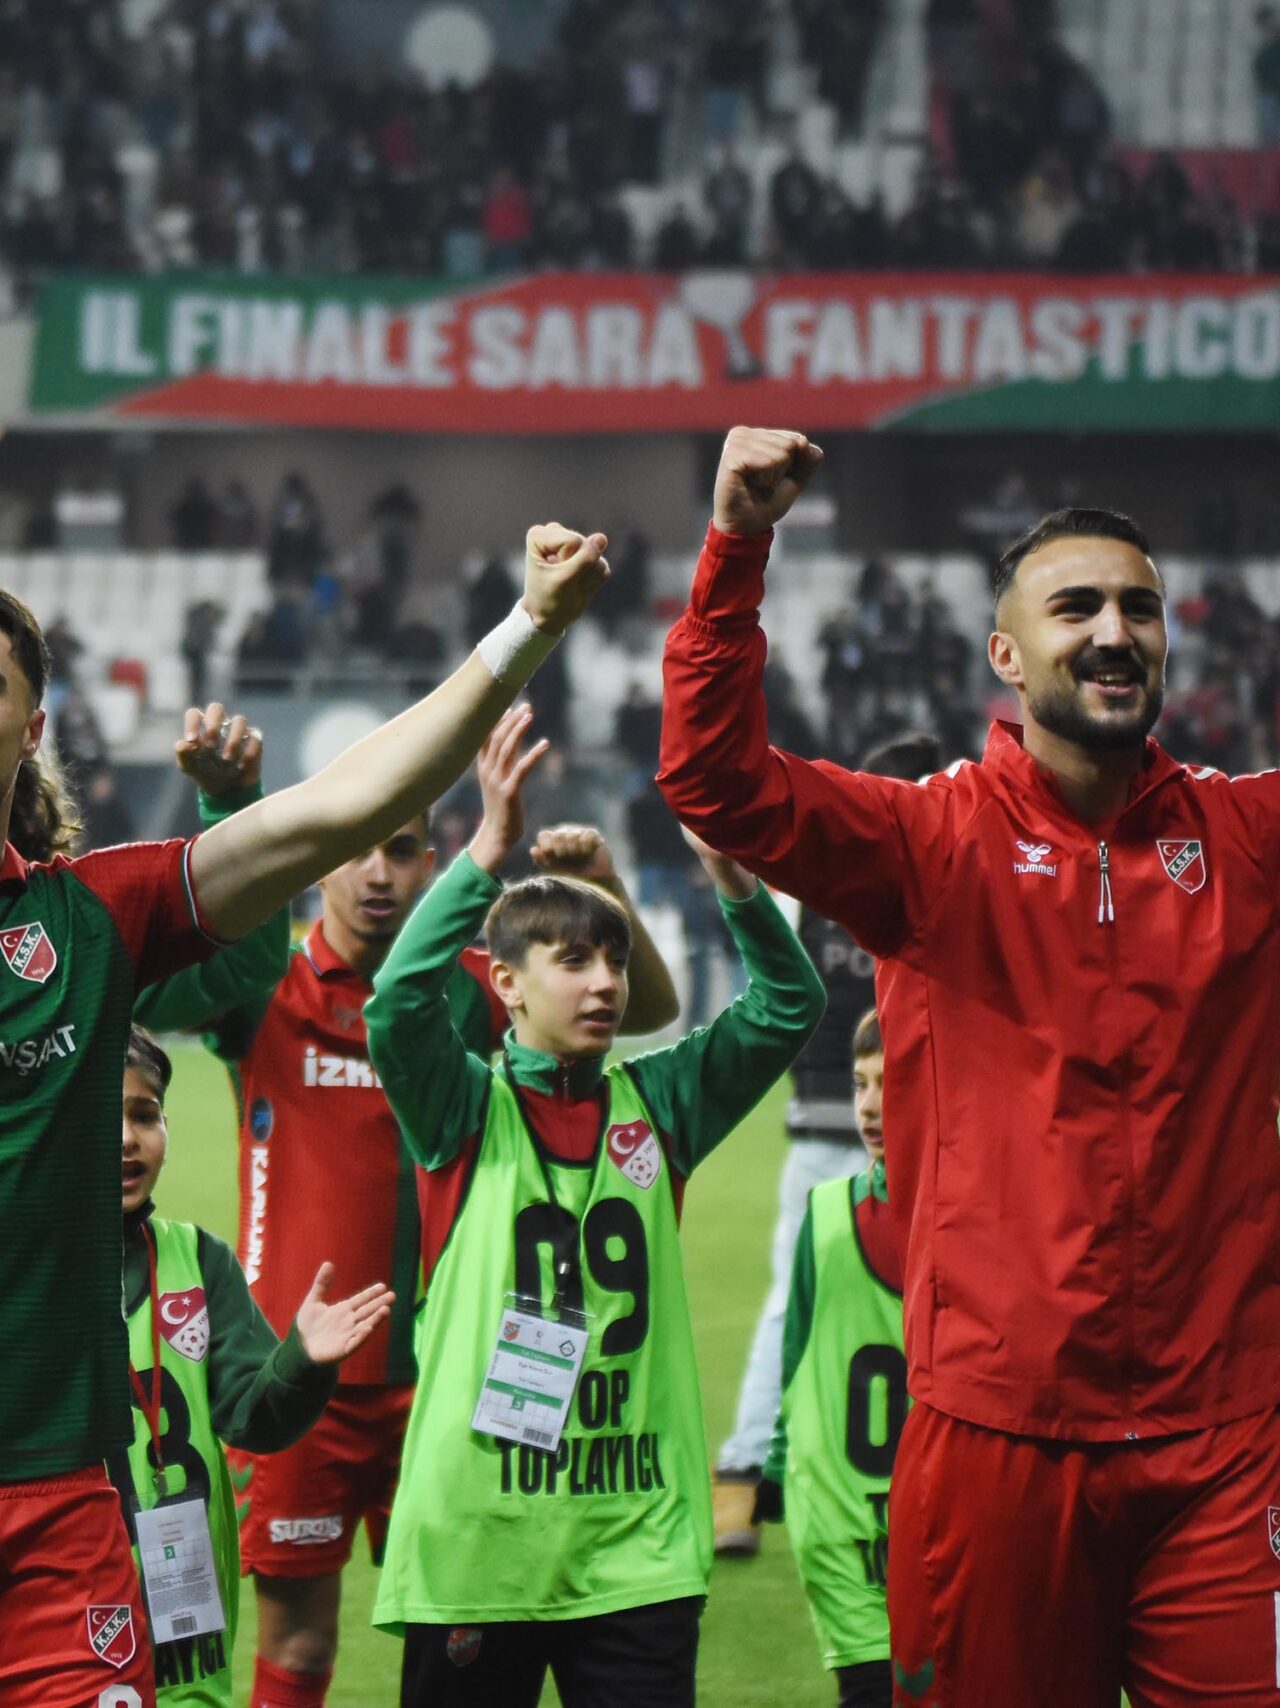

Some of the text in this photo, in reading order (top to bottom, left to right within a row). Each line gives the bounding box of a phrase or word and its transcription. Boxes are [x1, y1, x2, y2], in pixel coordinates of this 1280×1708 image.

[80, 288, 1280, 390] IL FINALE SARA FANTASTICO
[1013, 862, 1057, 877] hummel
[13, 933, 39, 968] K.S.K.
[304, 1047, 383, 1089] İZK
[516, 1198, 650, 1357] 09
[564, 1370, 630, 1430] OP
[494, 1432, 666, 1496] TOPLAYICI
[96, 1615, 125, 1648] K.S.K.
